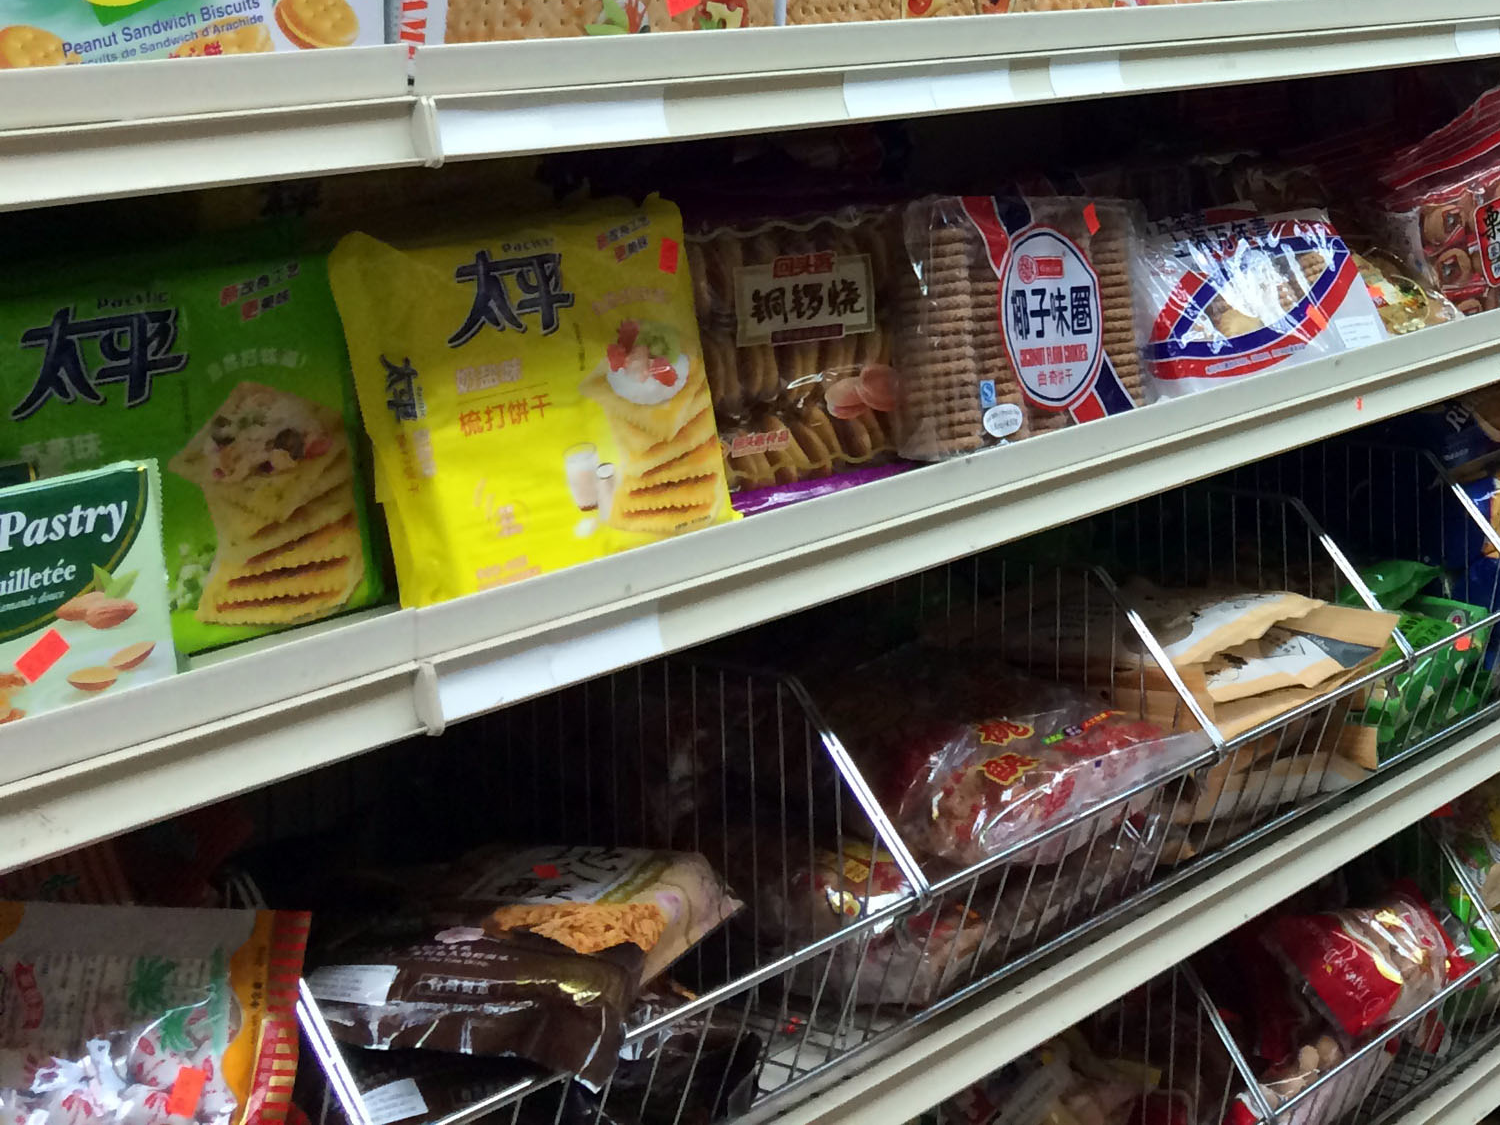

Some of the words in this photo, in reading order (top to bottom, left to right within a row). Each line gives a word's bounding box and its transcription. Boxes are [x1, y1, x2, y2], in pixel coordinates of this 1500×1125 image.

[61, 31, 119, 58] Peanut
[122, 10, 197, 42] Sandwich
[122, 46, 137, 58] de
[139, 30, 199, 53] Sandwich
[201, 13, 264, 38] d'Arachide
[448, 250, 575, 348] 太平
[751, 279, 865, 324] 铜锣烧
[1010, 286, 1093, 339] 椰子味圈
[11, 307, 189, 420] 太平
[459, 393, 552, 436] 梳打饼干
[0, 500, 128, 552] Pastry
